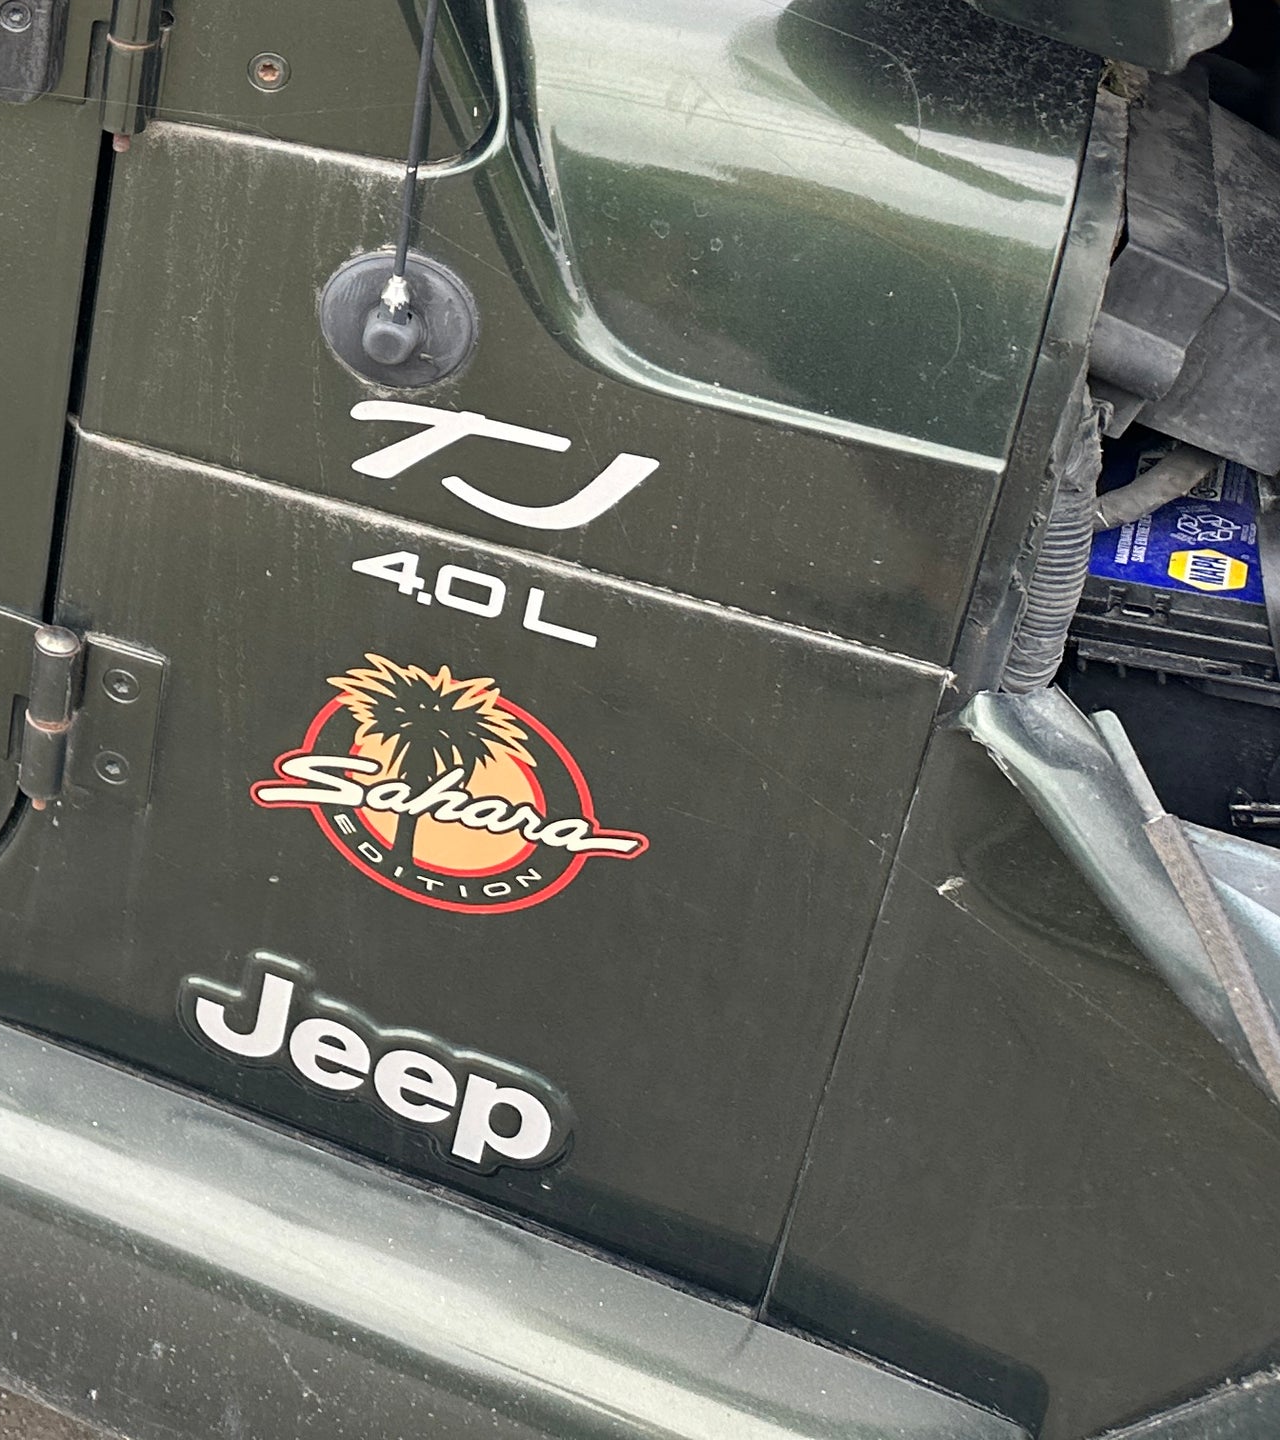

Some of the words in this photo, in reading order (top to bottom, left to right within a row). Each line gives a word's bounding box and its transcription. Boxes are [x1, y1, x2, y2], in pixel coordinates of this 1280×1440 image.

[350, 400, 660, 530] TJ
[1114, 523, 1135, 565] MAINTENANC
[1188, 554, 1228, 586] NAPA
[257, 755, 639, 853] Sahara
[334, 813, 543, 898] EDITION
[195, 972, 553, 1164] Jeep
